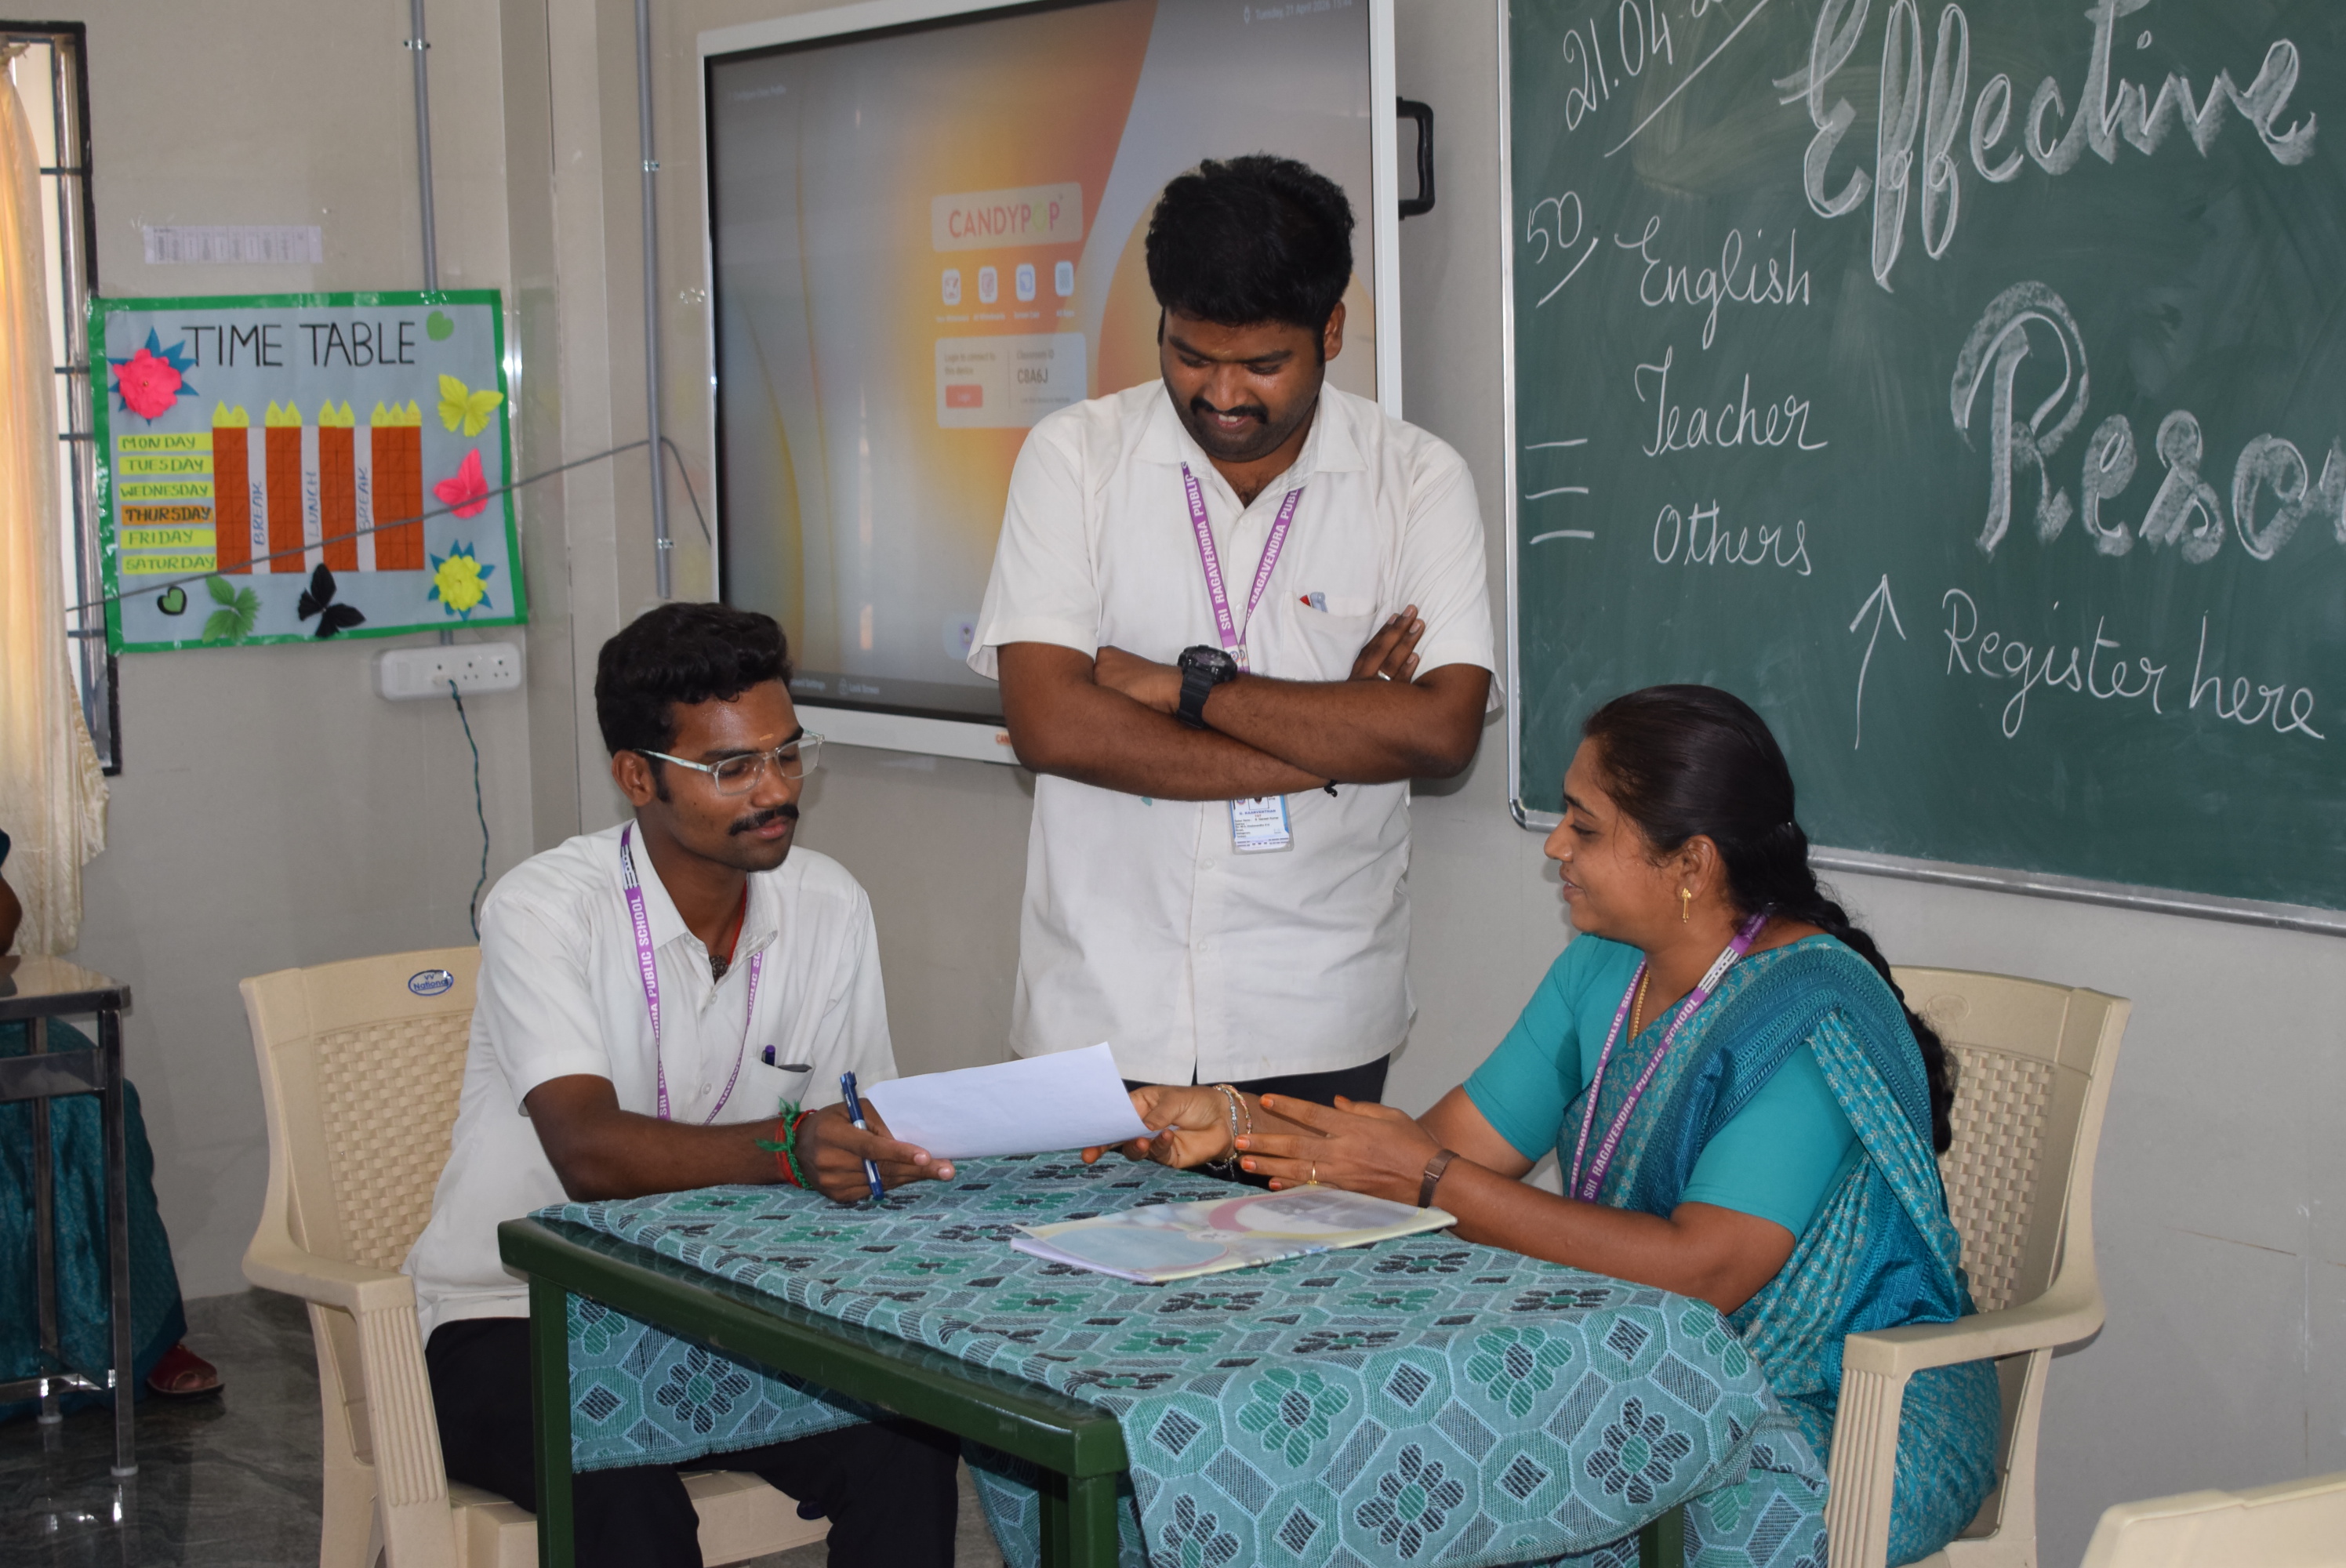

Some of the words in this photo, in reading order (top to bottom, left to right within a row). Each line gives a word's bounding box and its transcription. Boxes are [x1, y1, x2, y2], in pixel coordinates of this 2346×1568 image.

[1563, 0, 1725, 131] 21.04.
[1771, 0, 2317, 292] Effective
[1614, 216, 1810, 350] English
[181, 324, 283, 367] TIME
[300, 321, 416, 367] TABLE
[1635, 345, 1828, 457] Teacher
[122, 435, 196, 450] MONDAY
[126, 458, 204, 472] TUESDAY
[120, 484, 208, 498] WEDNESDAY
[125, 506, 212, 522] THURSDAY
[252, 481, 265, 546] BREAK
[306, 471, 320, 538] LUNCH
[358, 466, 372, 532] BREAK
[1185, 474, 1204, 517] PUBLIC
[125, 555, 216, 570] SATURDAY
[129, 530, 194, 546] FRIDAY
[1197, 521, 1225, 604] RAGAVENDRA
[1251, 524, 1286, 604] RAGAVENDRA
[1653, 499, 1811, 575] Others
[1218, 608, 1231, 630] SRI
[1942, 588, 2167, 739] Register
[2189, 609, 2326, 739] here
[631, 895, 649, 947] SCHOOL
[641, 951, 657, 997] PUBLIC
[1576, 1066, 1603, 1156] RAGAVENDRA
[1601, 1012, 1623, 1060] PUBLIC
[1583, 1178, 1598, 1200] SRI
[1592, 1095, 1636, 1177] RAGAVENDRA
[1635, 1047, 1665, 1093] PUBLIC
[1665, 999, 1700, 1046] SCHOOL
